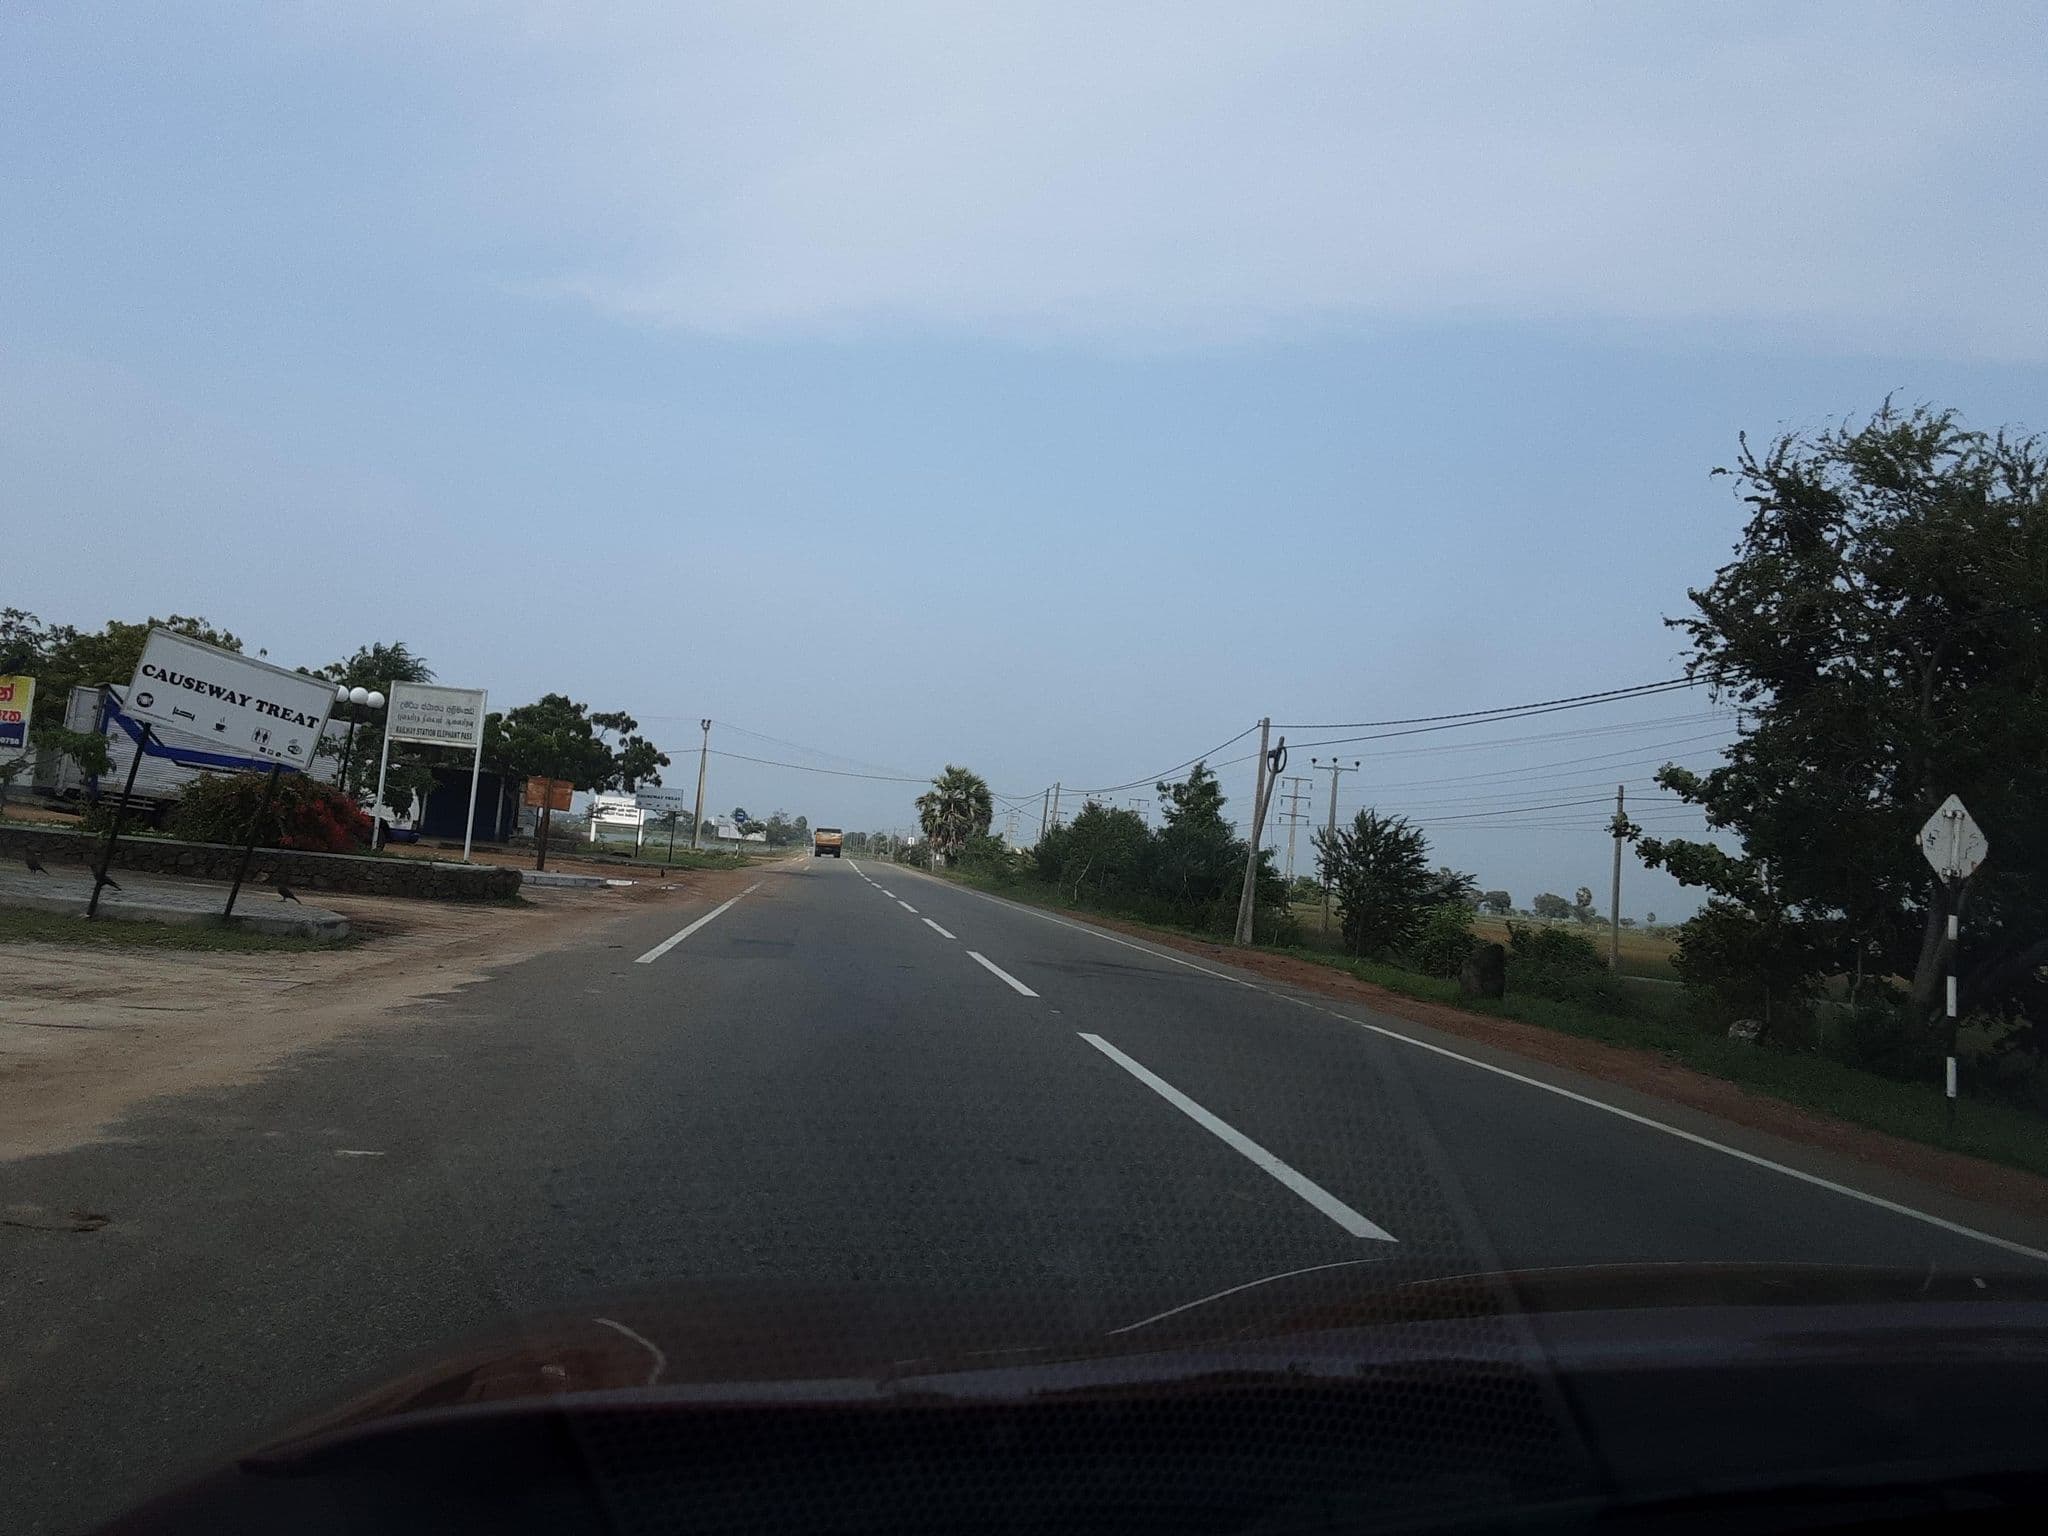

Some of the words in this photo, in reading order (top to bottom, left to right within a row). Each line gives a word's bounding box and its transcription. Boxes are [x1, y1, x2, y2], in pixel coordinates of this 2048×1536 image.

[142, 664, 252, 707] CAUSEWAY
[256, 699, 320, 729] TREAT
[396, 726, 416, 736] RAILWAY
[416, 728, 436, 737] STATION
[437, 729, 460, 739] ELEPHANT
[460, 732, 473, 740] PASS
